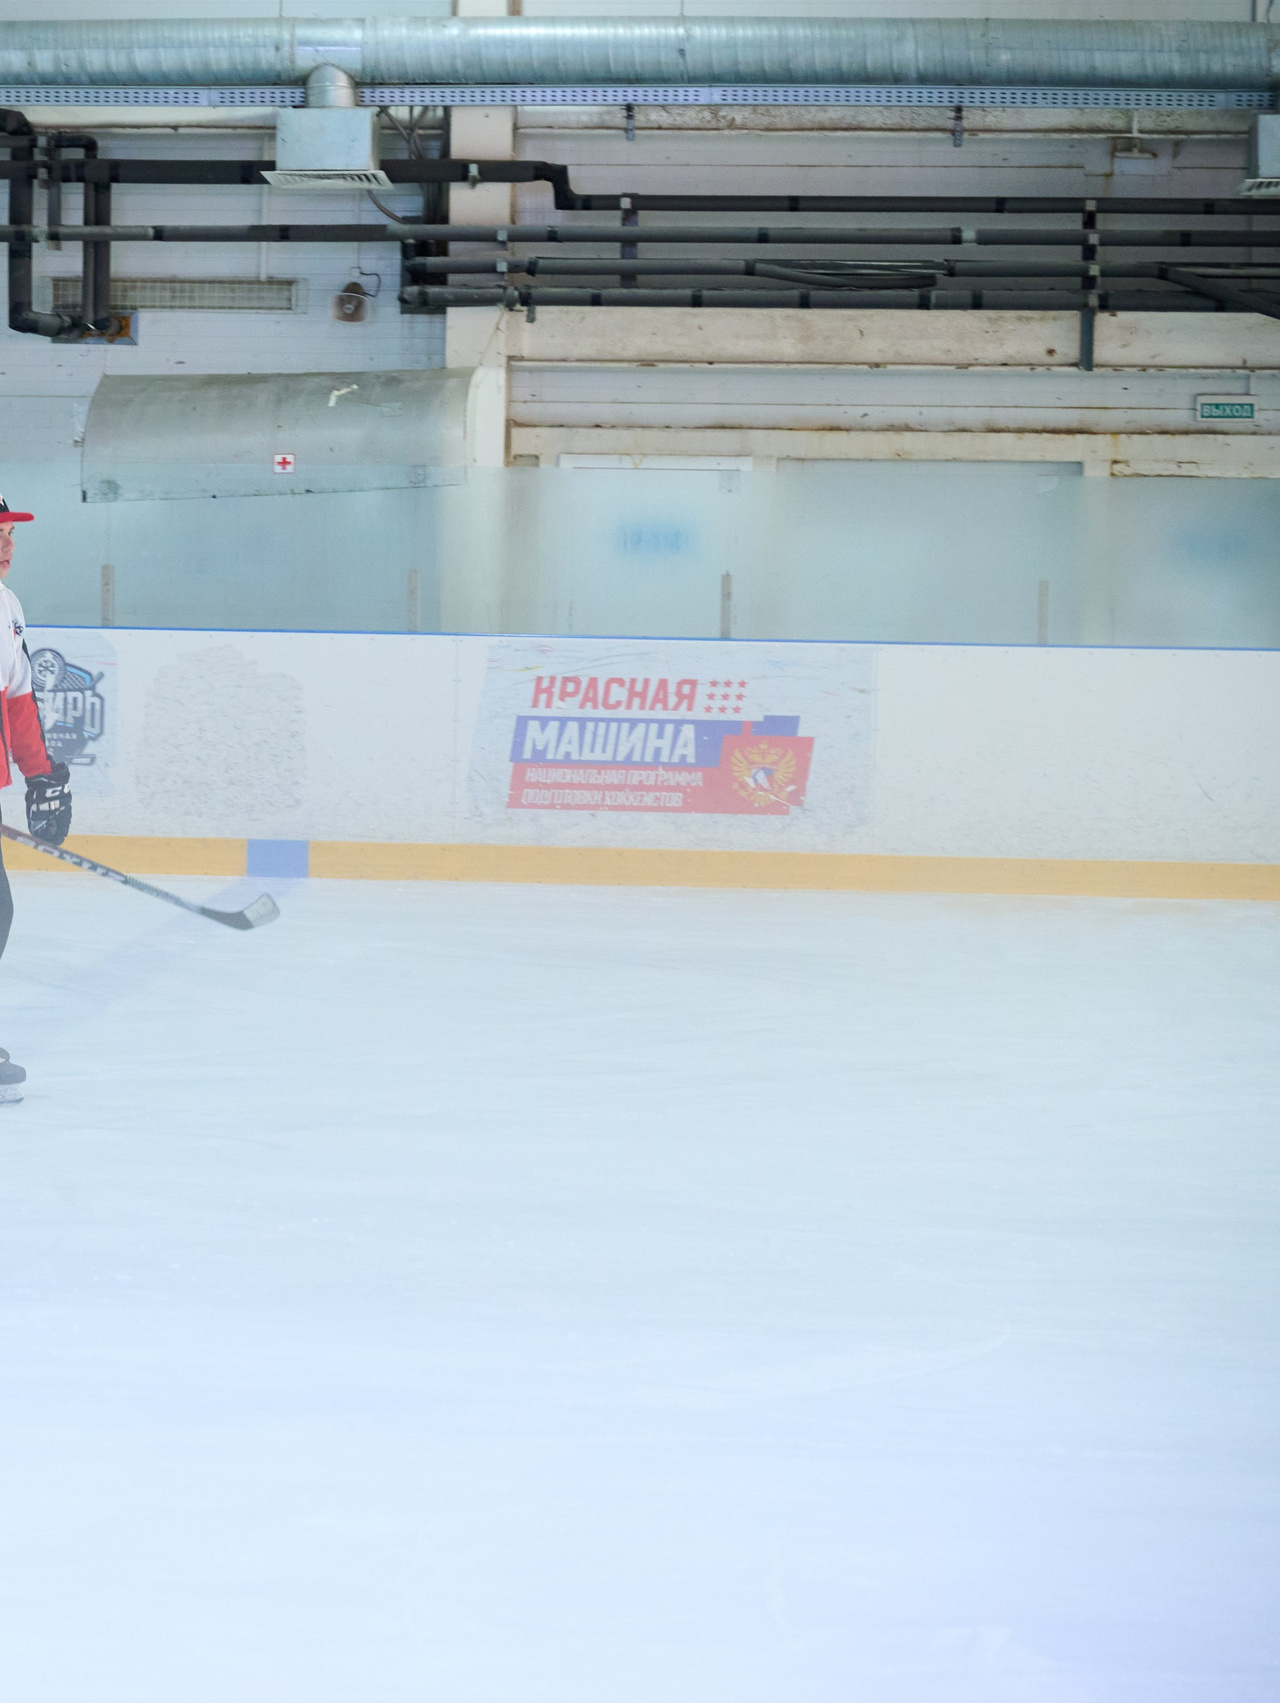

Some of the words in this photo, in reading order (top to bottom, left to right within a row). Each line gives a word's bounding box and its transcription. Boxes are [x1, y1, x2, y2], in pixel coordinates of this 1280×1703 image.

[1203, 405, 1252, 417] ВЫХОД
[531, 676, 698, 712] КРАСНАЯ
[523, 720, 696, 763] МАШИНА
